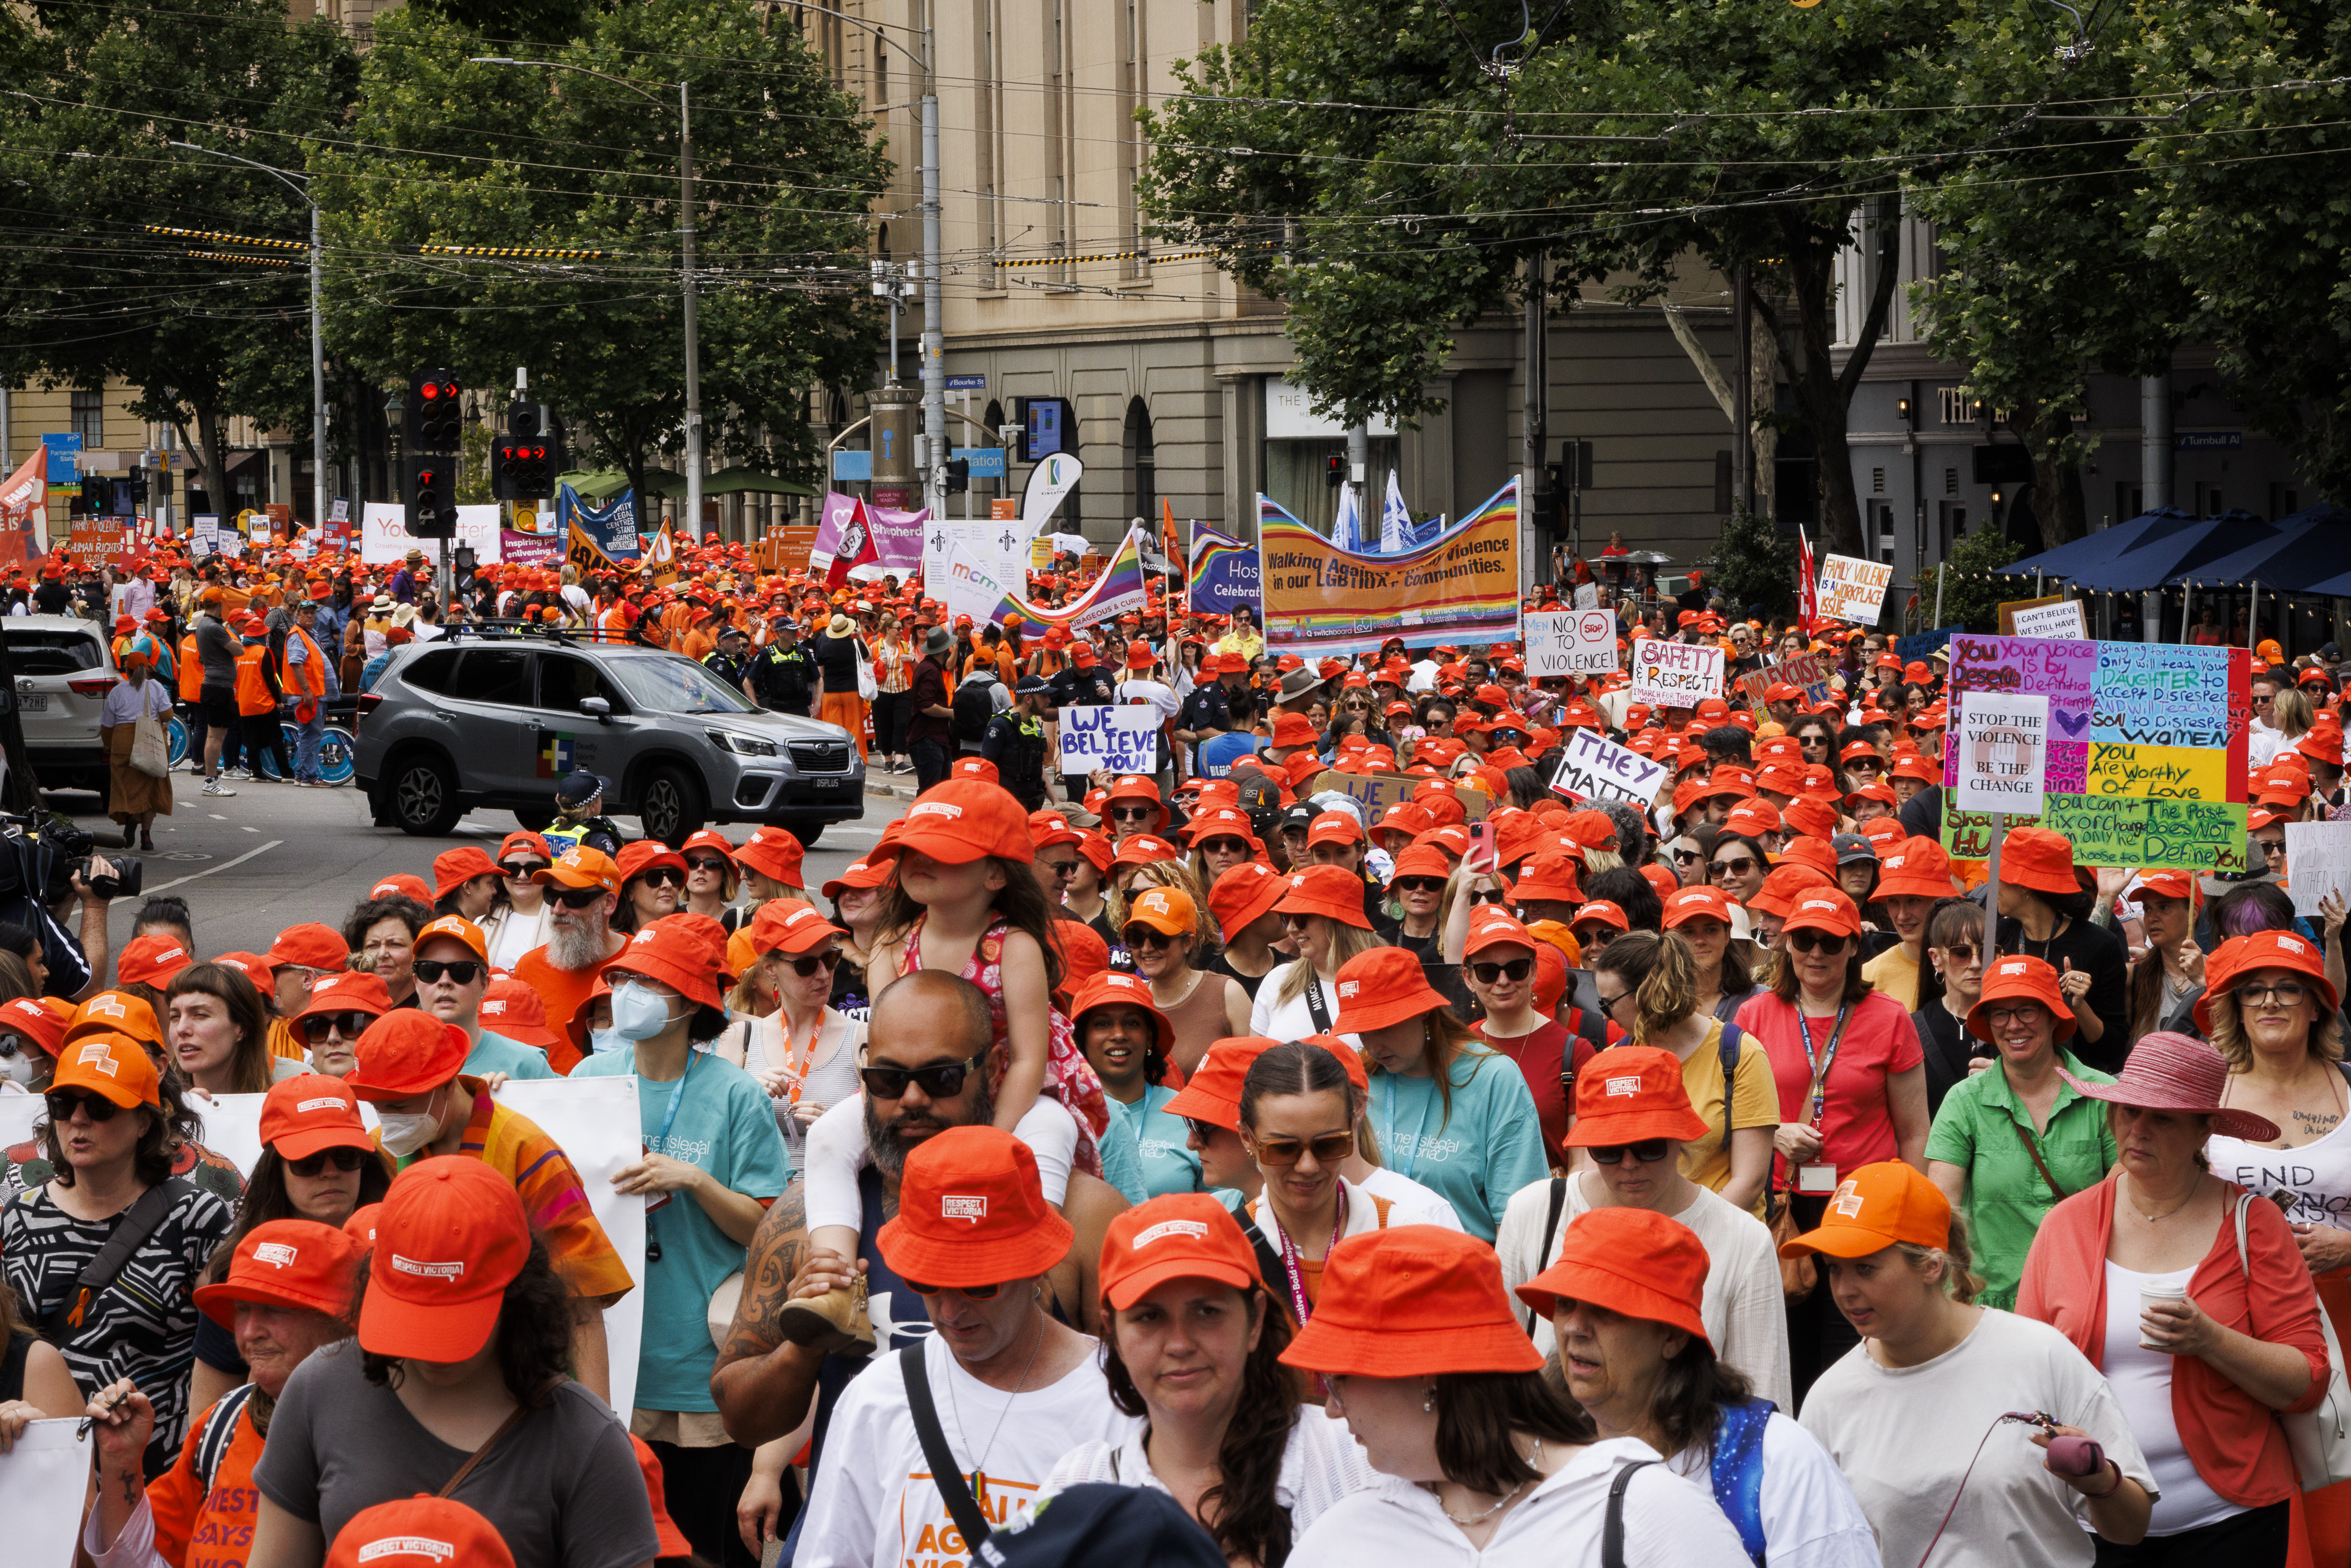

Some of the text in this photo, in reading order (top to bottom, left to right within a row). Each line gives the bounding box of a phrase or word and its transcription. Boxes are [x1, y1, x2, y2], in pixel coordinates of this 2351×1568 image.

[1278, 395, 1301, 406] THE
[2188, 435, 2227, 446] Turnbull
[613, 510, 634, 521] LEGAL
[72, 521, 121, 533] FAMILY VIOLENCE
[606, 518, 634, 529] CENTRES
[616, 525, 635, 535] STAND
[872, 523, 923, 539] Shepherd
[505, 538, 542, 548] Inspiring
[612, 533, 636, 542] AGAINST
[71, 542, 121, 553] HUMAN RIGHTS
[507, 548, 552, 559] enlivening
[1267, 552, 1323, 571] Walking
[1446, 538, 1510, 562] Violence
[84, 553, 108, 563] ISSUE
[1823, 559, 1893, 588] FAMILY VIOLENCE
[1273, 574, 1284, 590] in
[1287, 574, 1311, 589] our
[1214, 584, 1261, 597] Celebrat
[1579, 590, 1593, 606] ANGRY
[1821, 579, 1883, 606] IS A WORKPLACE
[1424, 605, 1469, 616] Transcend
[1819, 596, 1847, 618] ISSUE.
[2046, 606, 2077, 619] BELIEVE
[1070, 605, 1112, 628] URAGEOUS
[1426, 614, 1458, 624] Australia
[1314, 628, 1353, 637] switchboard
[1553, 616, 1603, 634] NO STOP
[2034, 623, 2054, 634] STILL
[2054, 619, 2077, 629] HAVE
[1526, 634, 1575, 649] SAY TO
[2065, 631, 2076, 640] SO
[1541, 649, 1614, 670] VIOLENCE!
[1642, 642, 1720, 678] SAFETY
[1743, 673, 1768, 703] NO
[1766, 655, 1823, 687] EXCUSE
[2101, 668, 2225, 690] DAUGHTER to
[1638, 688, 1660, 698] MARCH
[1675, 692, 1697, 702] THOSE
[1071, 706, 1119, 733] WE
[1969, 713, 2041, 728] STOP THE
[1063, 729, 1157, 755] BELIEVE
[1968, 730, 2041, 746] VIOLENCE
[576, 742, 598, 752] Deadly
[575, 753, 596, 761] Sports
[1101, 753, 1147, 773] YOU!
[1578, 731, 1659, 784] THEY
[1976, 762, 2029, 775] BE THE
[817, 779, 839, 787] DSPLUS
[1970, 779, 2033, 793] CHANGE
[2146, 783, 2202, 799] Love
[2142, 799, 2180, 818] The
[2147, 819, 2236, 840] Does NOT
[2146, 836, 2216, 864] Define
[1610, 1085, 1638, 1094] VICTORIA
[300, 1100, 324, 1109] RESPECT
[2237, 1166, 2314, 1188] END
[947, 1199, 981, 1207] RESPECT
[946, 1207, 983, 1215] VICTORIA
[394, 1259, 460, 1274] RESPECT VICTORIA
[1289, 1269, 1301, 1291] Bold
[192, 1523, 254, 1547] SAYS
[362, 1539, 450, 1559] RESPECT VICTORIA
